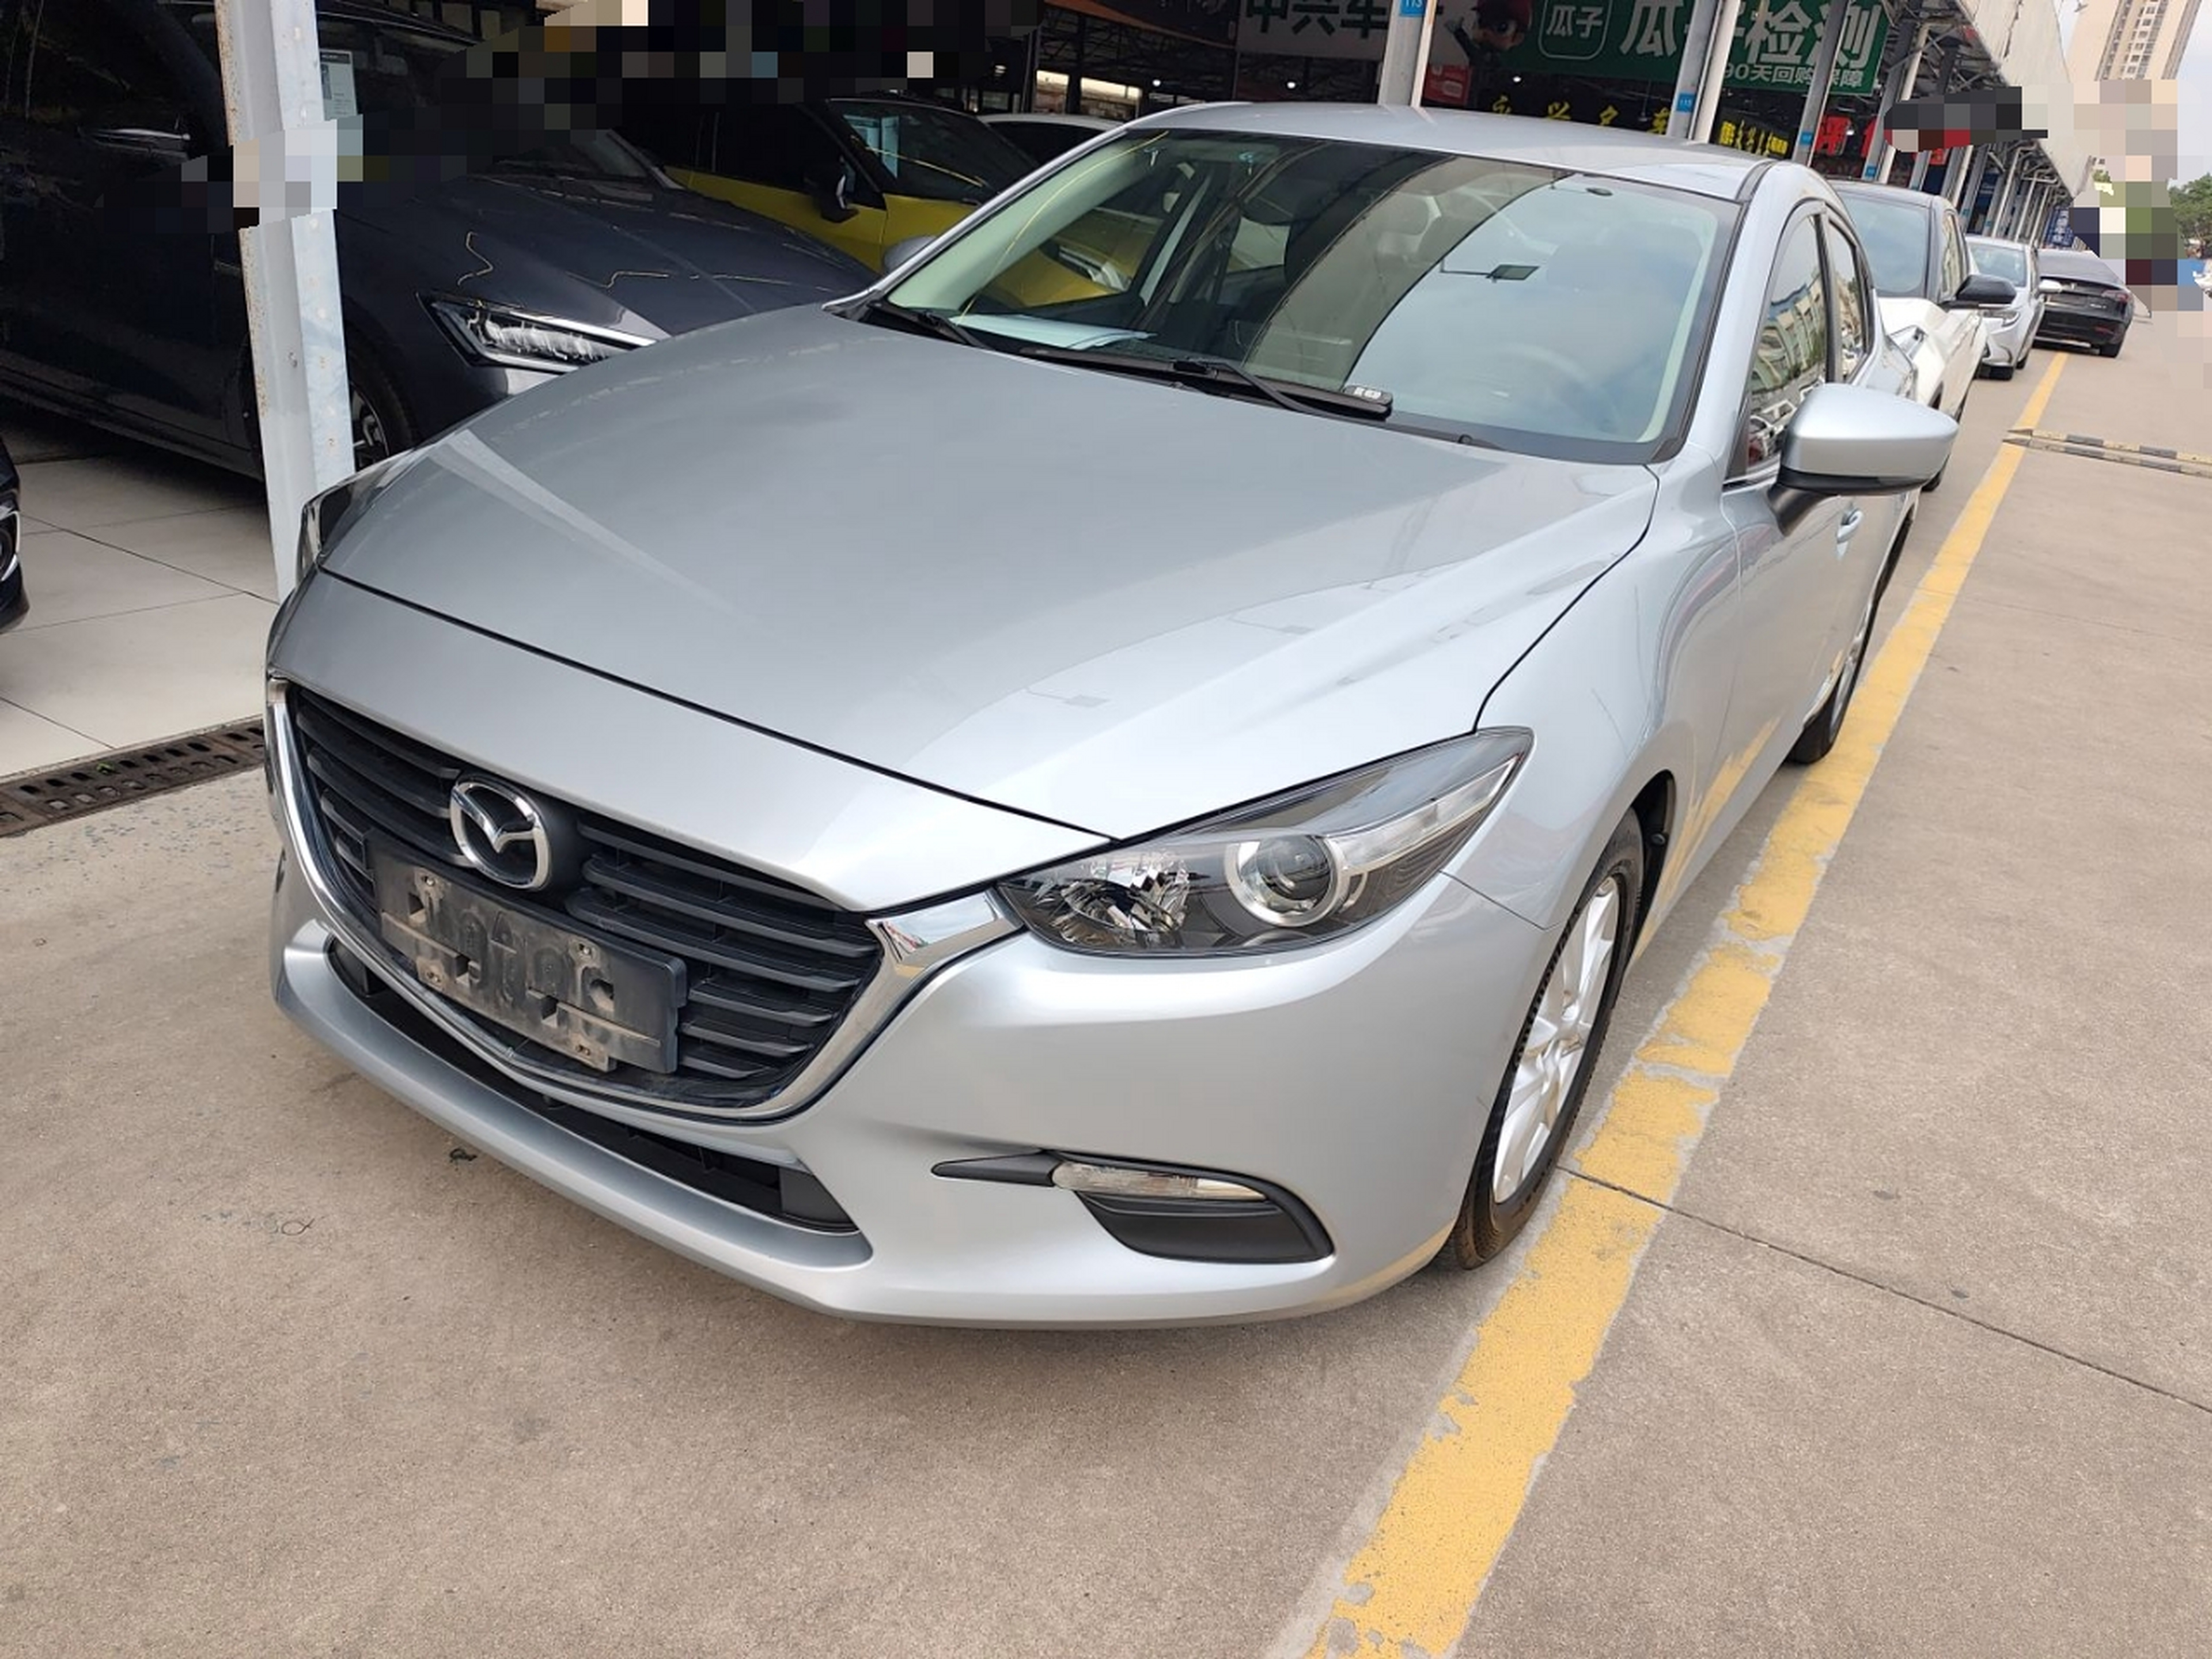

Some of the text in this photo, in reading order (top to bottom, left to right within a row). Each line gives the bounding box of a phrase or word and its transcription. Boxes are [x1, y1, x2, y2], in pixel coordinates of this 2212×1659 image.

[1546, 5, 1603, 38] 瓜子
[1619, 0, 1882, 69] 瓜检测
